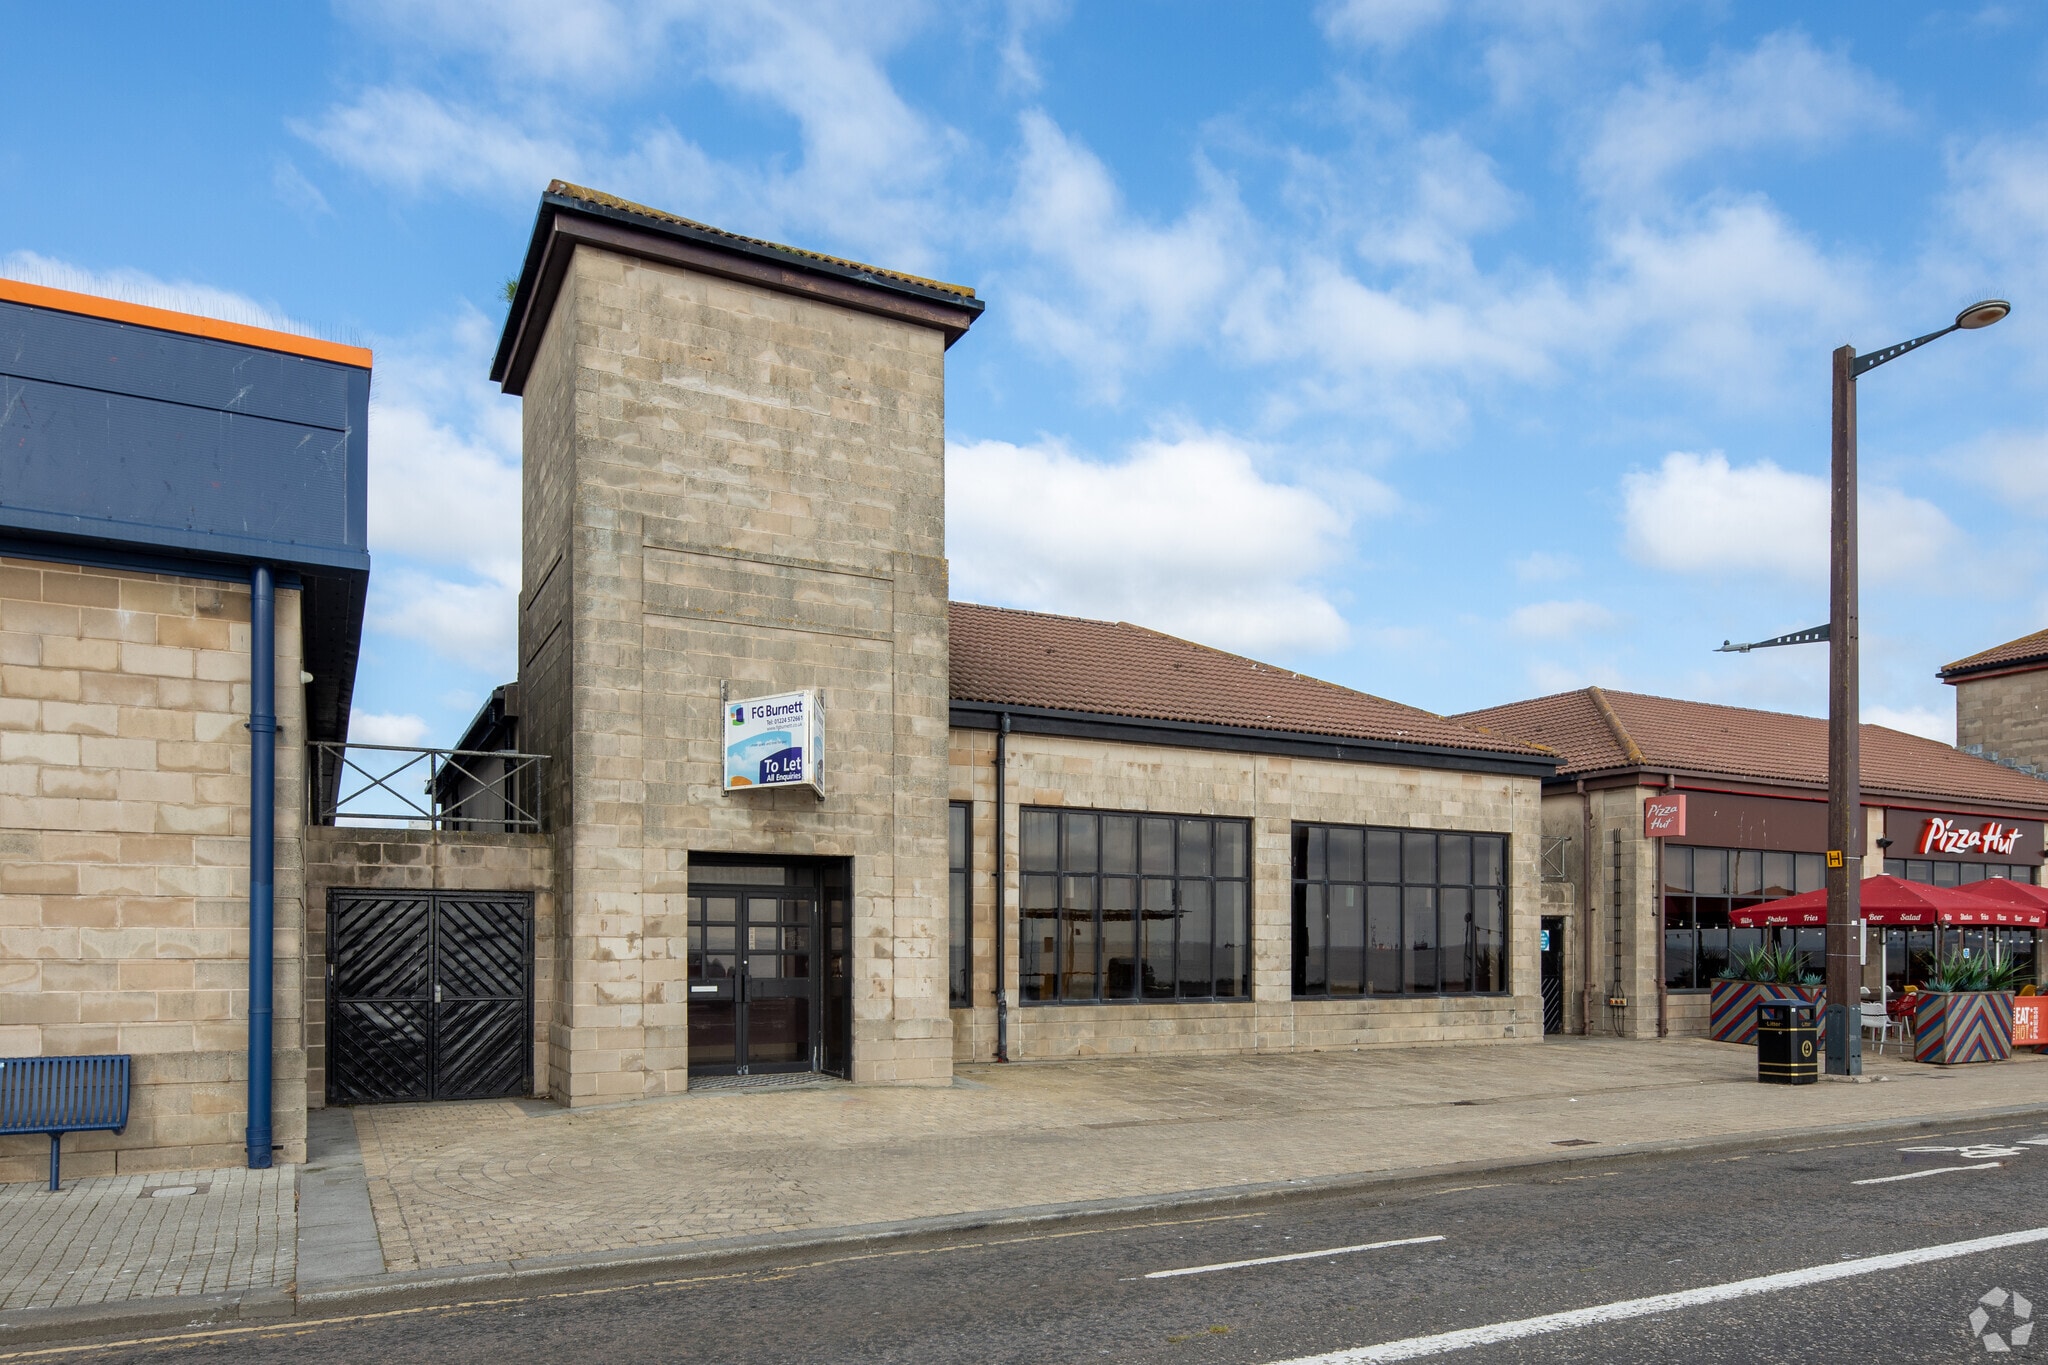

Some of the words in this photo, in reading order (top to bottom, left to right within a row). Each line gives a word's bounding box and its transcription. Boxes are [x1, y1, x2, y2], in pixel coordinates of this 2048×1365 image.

[751, 705, 764, 719] FG
[766, 700, 803, 717] Burnett
[764, 759, 779, 773] To
[783, 757, 801, 771] Let
[767, 773, 775, 782] All
[776, 771, 802, 782] Enquiries
[1647, 804, 1678, 818] Pizza
[1651, 817, 1673, 830] Hut
[1923, 817, 1981, 854] Pizza
[1982, 821, 2023, 855] Hut
[1829, 852, 1841, 866] H
[1803, 914, 1818, 922] Fries
[1868, 913, 1884, 921] Beer
[1900, 913, 1922, 921] Salad
[2015, 1006, 2030, 1025] EAT
[2015, 1024, 2029, 1040] HOT
